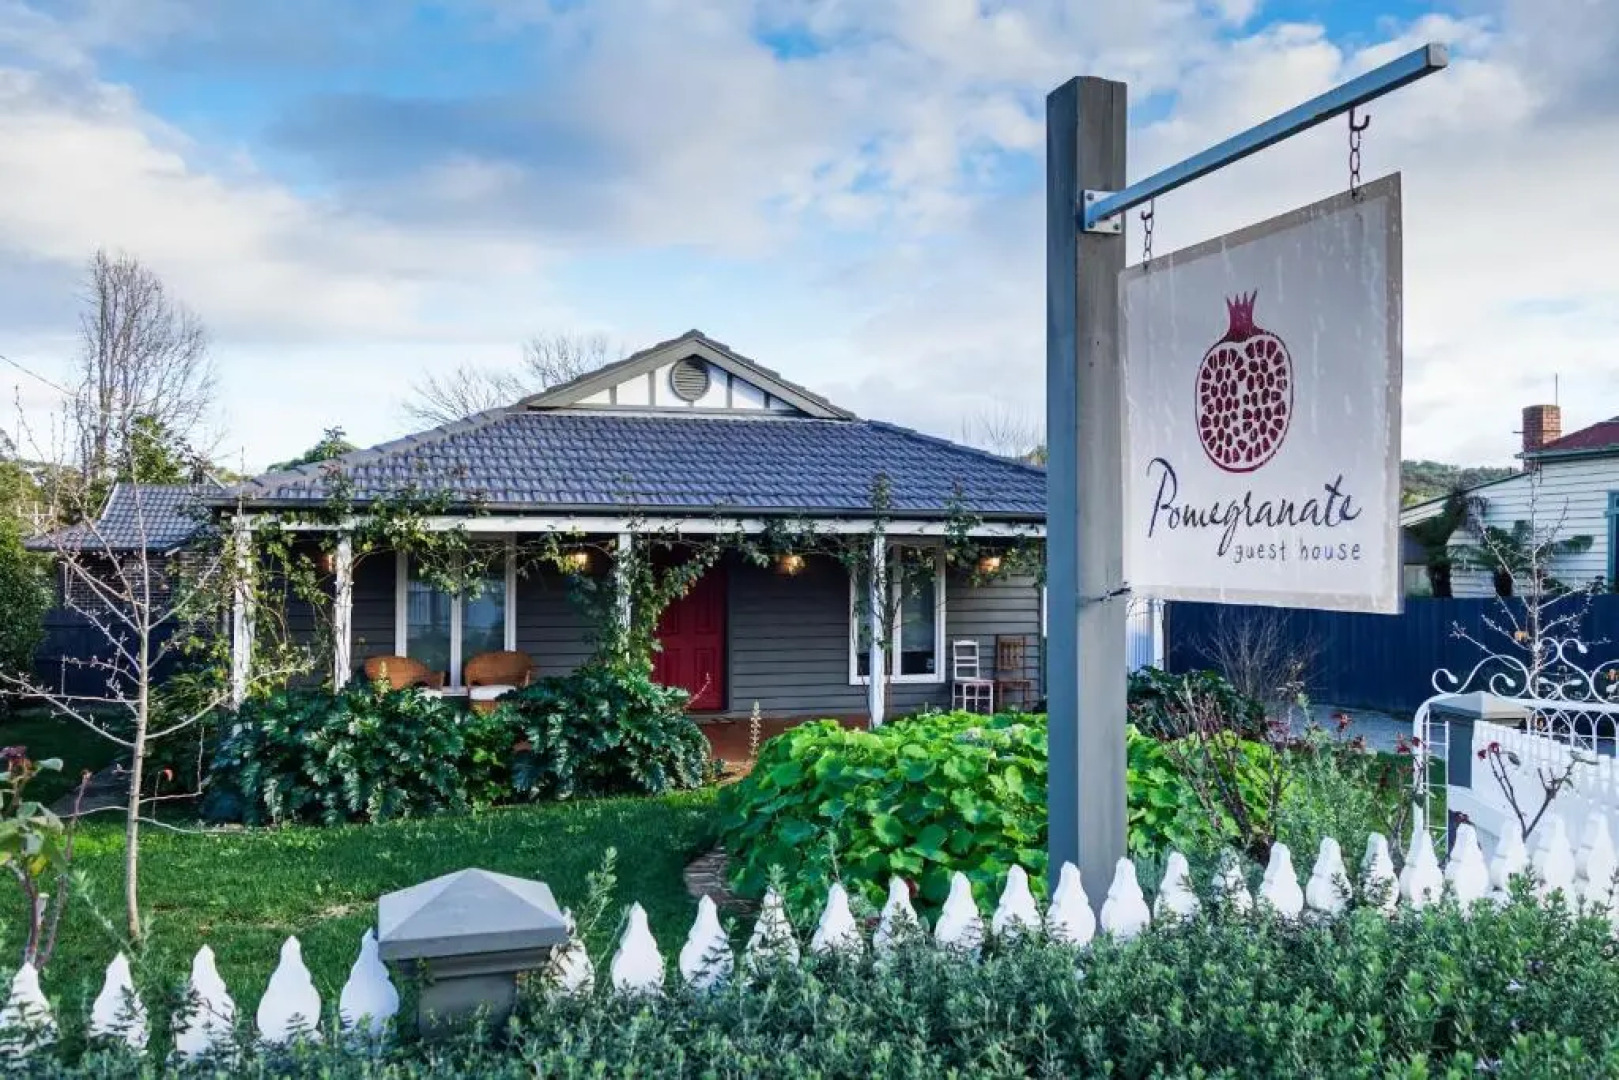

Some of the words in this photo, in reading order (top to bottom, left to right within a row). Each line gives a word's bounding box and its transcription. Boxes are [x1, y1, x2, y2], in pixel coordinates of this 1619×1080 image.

[1147, 457, 1362, 557] Pomegranate
[1234, 541, 1286, 563] guest
[1299, 539, 1361, 560] house
